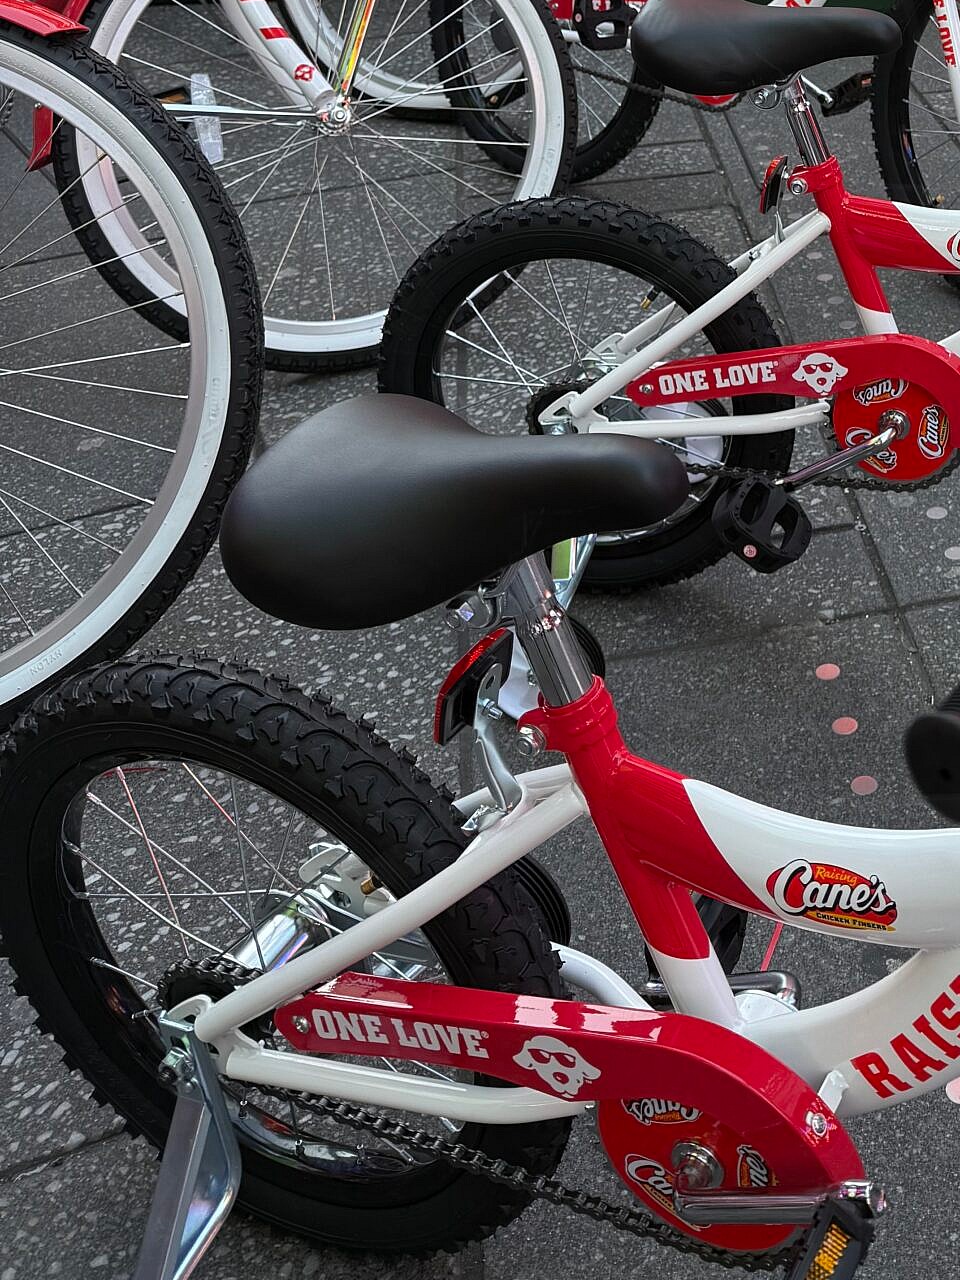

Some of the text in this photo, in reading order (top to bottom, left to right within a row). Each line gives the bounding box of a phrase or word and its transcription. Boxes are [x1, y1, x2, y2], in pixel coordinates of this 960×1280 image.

[658, 369, 709, 396] ONE
[774, 859, 897, 916] Cane's
[815, 866, 858, 886] Raising
[816, 912, 887, 931] CHICKEN FINGERS
[311, 1008, 389, 1045] ONE
